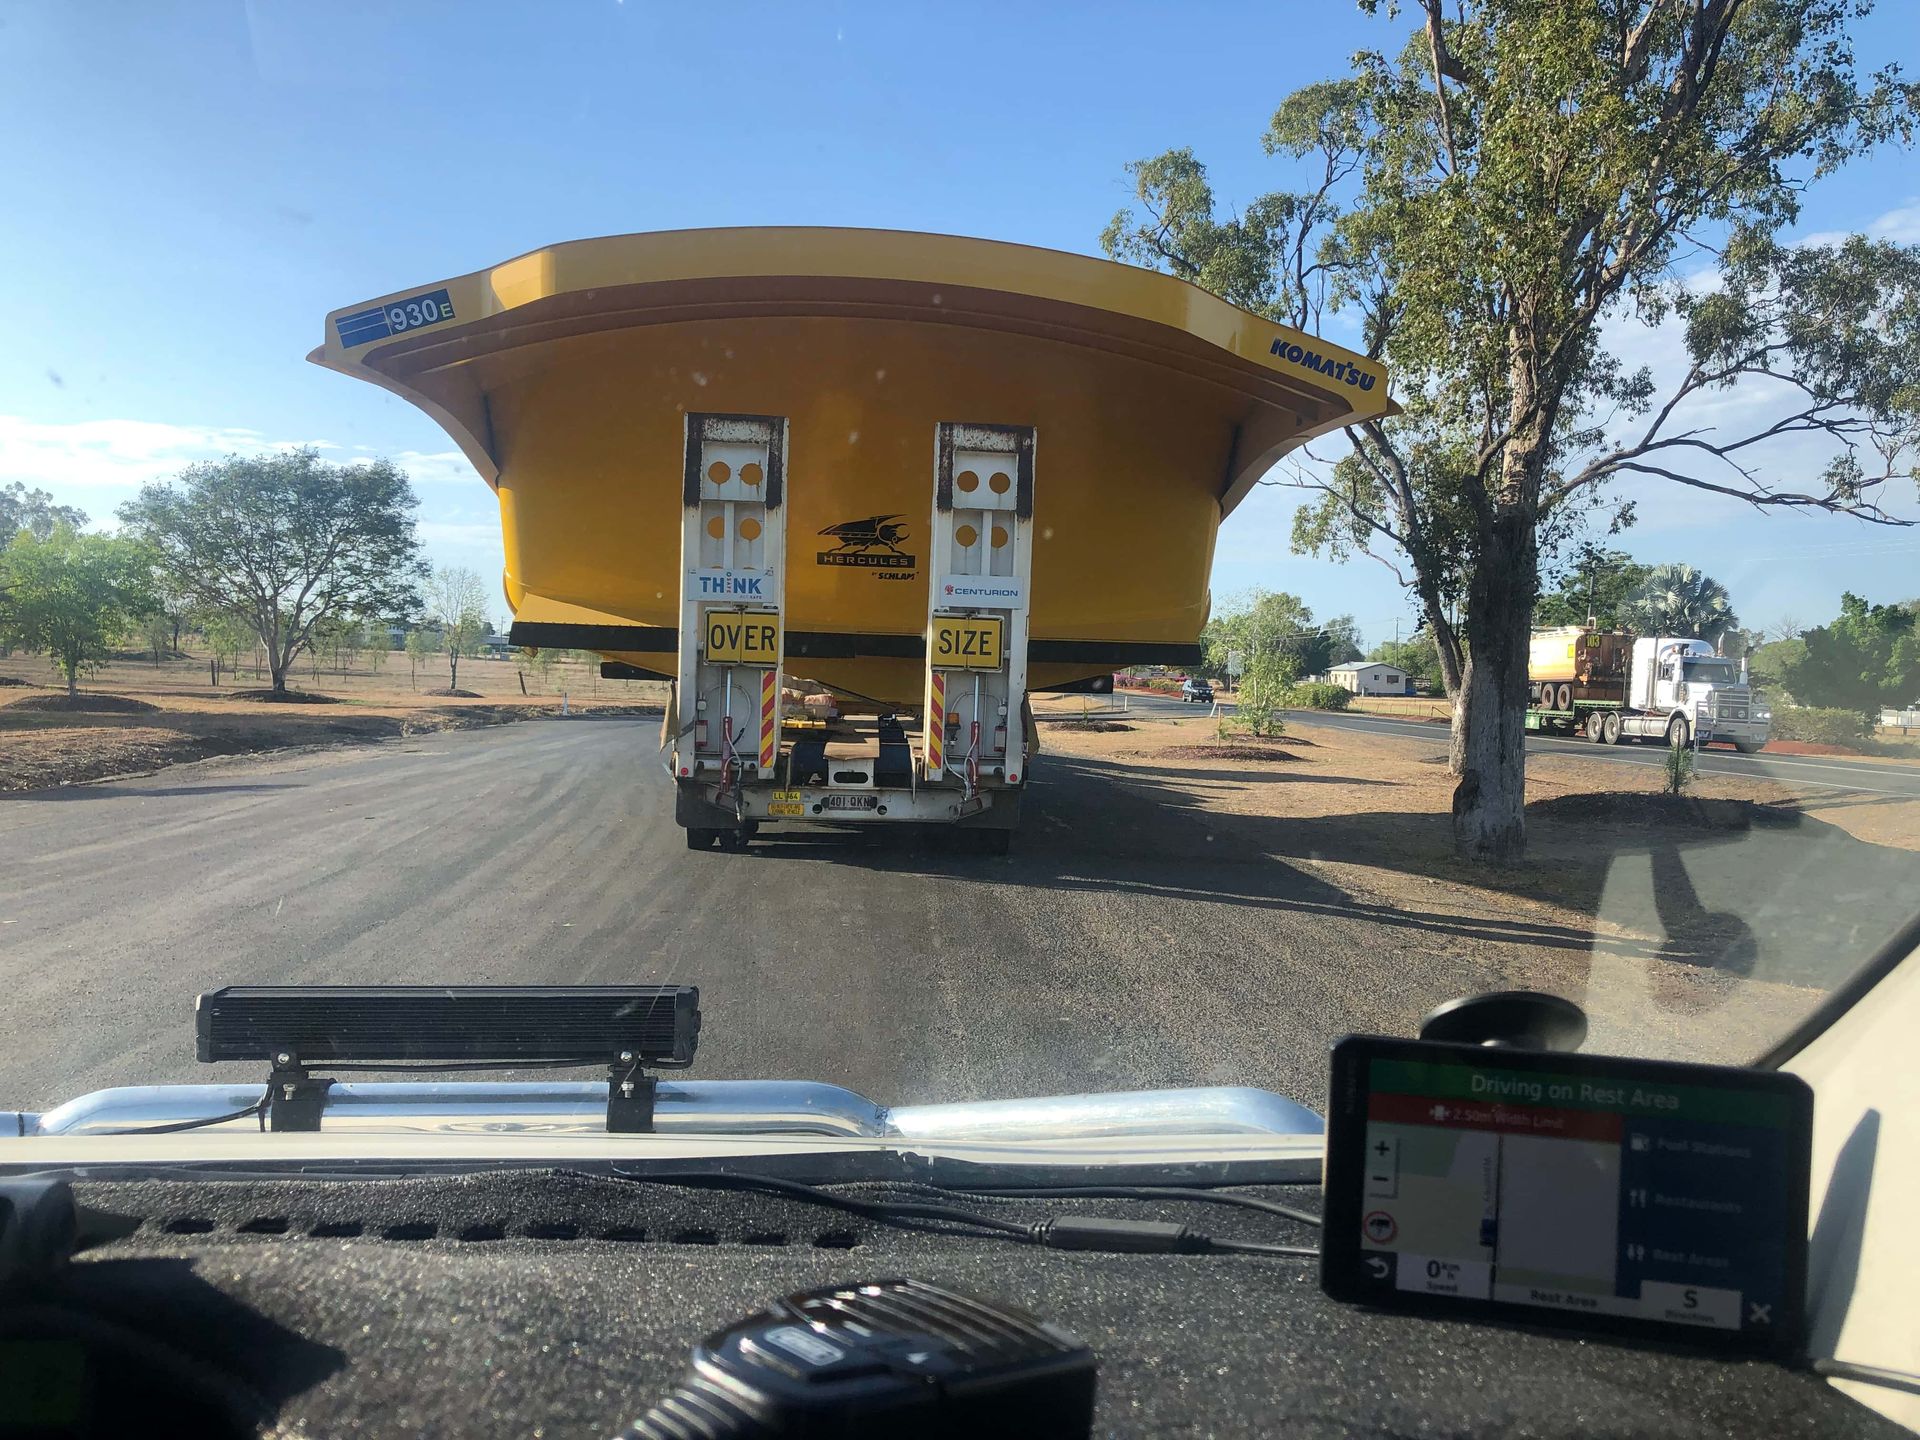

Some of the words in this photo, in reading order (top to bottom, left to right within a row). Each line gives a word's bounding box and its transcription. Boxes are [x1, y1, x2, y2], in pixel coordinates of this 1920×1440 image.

[1270, 338, 1376, 391] KOMATSU
[824, 555, 908, 565] HERCULES
[955, 588, 1018, 597] CENTURION
[711, 624, 776, 651] OVER
[938, 629, 992, 656] SIZE
[1586, 634, 1600, 647] 103
[1471, 1074, 1542, 1101] Driving
[1548, 1085, 1573, 1100] on
[1580, 1084, 1625, 1105] Rest
[1631, 1088, 1680, 1110] Area
[1427, 1260, 1440, 1278] 0
[1530, 1289, 1562, 1304] Rest
[1566, 1294, 1597, 1308] Area
[1684, 1290, 1698, 1308] S
